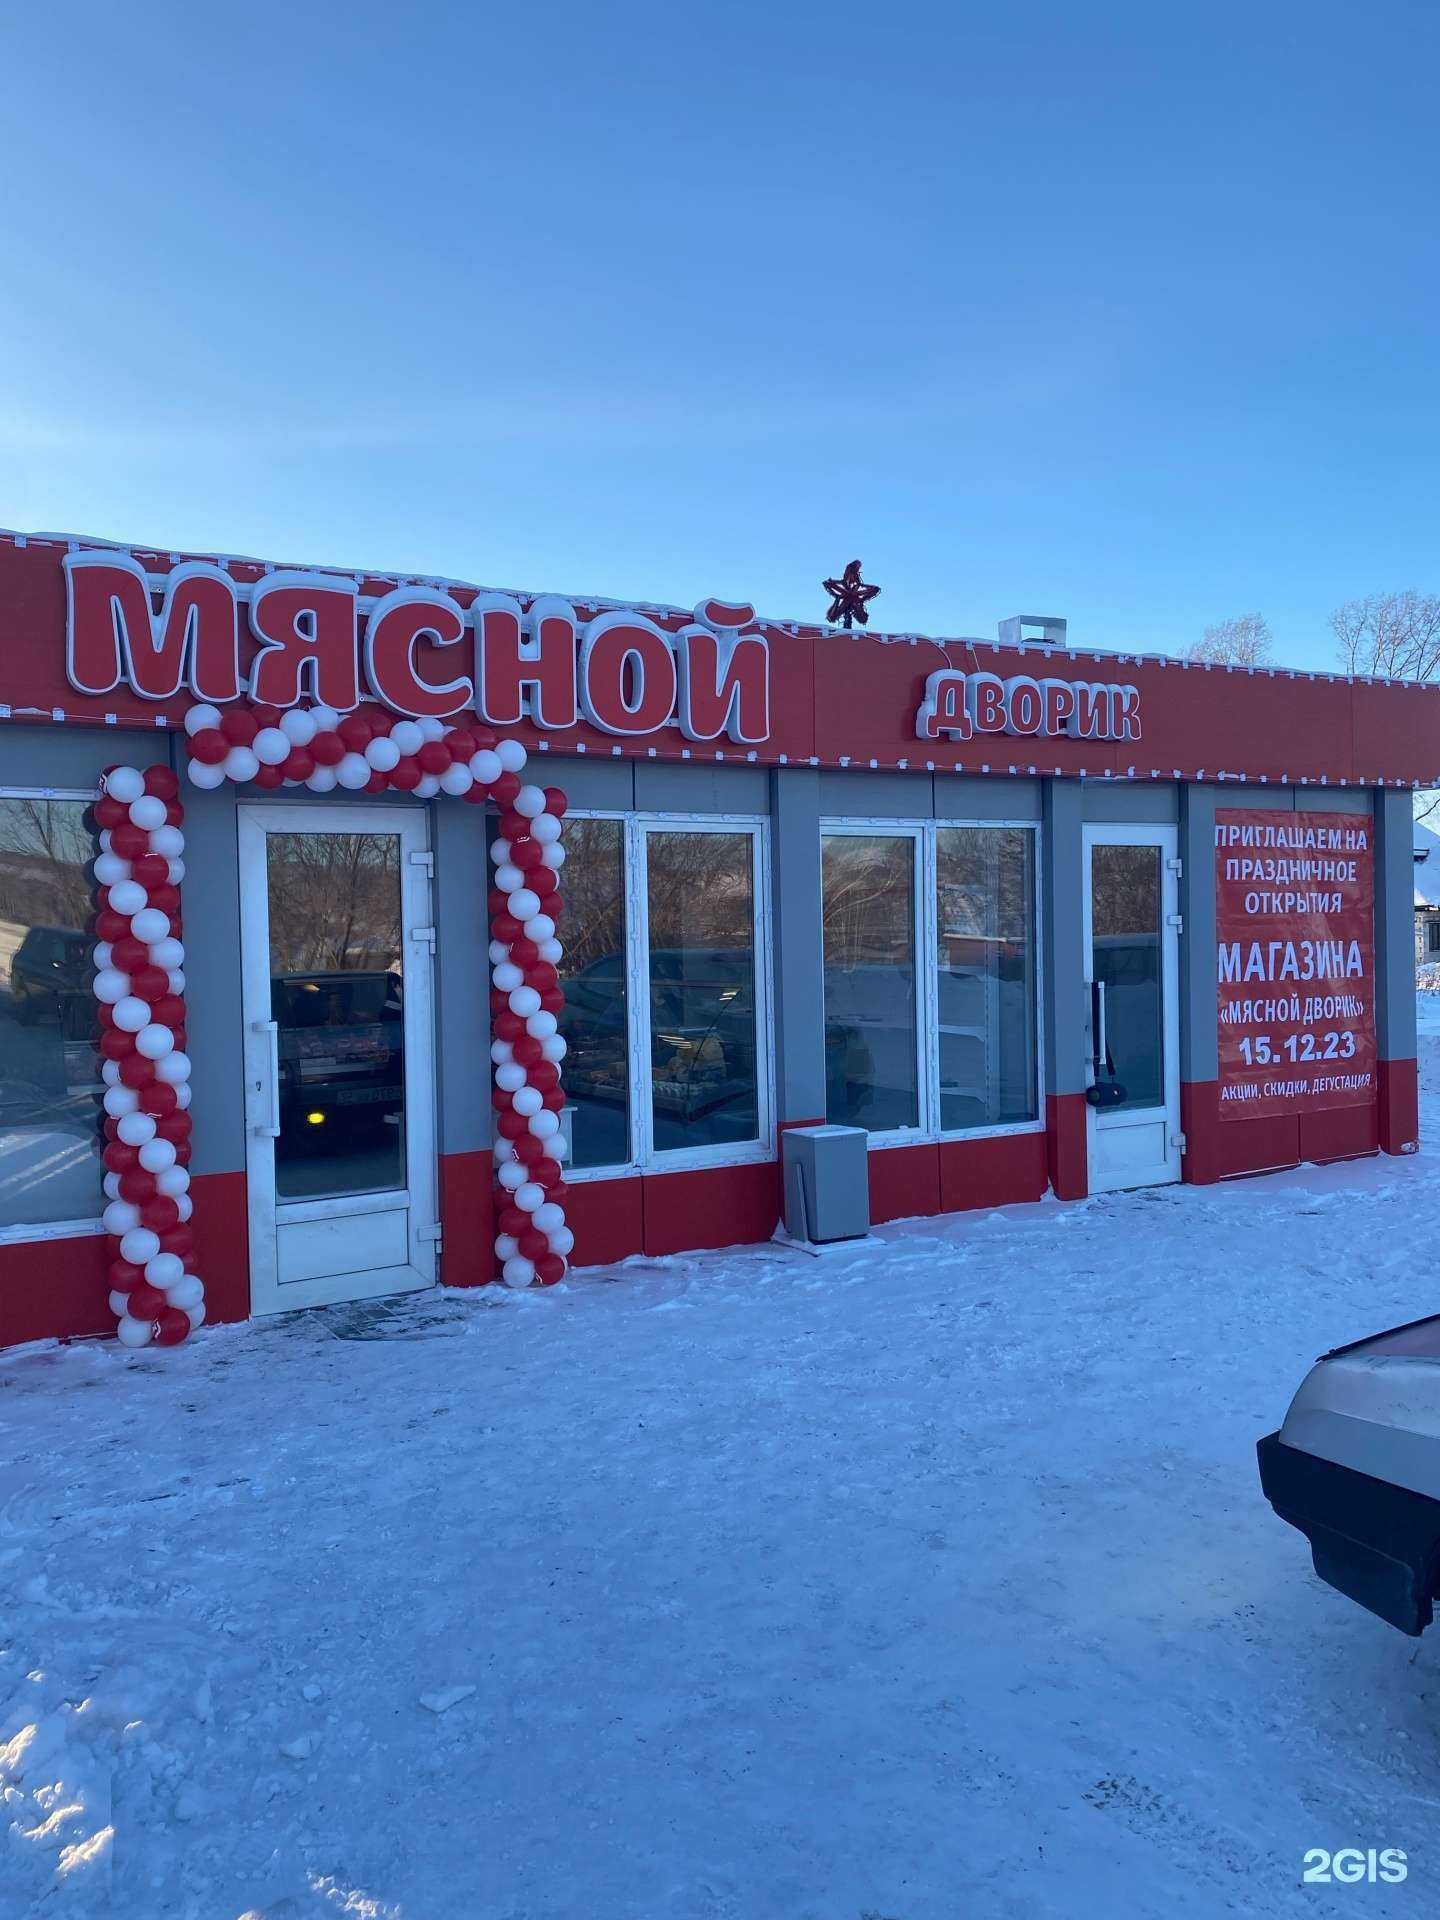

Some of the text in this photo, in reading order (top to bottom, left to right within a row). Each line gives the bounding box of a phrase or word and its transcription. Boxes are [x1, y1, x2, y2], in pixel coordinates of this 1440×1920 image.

[63, 552, 1141, 743] МЯСНОЙ ДВОРИК
[1214, 825, 1367, 850] ПРИГЛАШАЕМ НА
[1226, 859, 1357, 885] ПРАЗДНИЧНОЕ
[1245, 892, 1342, 914] ОТКРЫТИЯ
[1218, 940, 1363, 983] МАГАЗИНА
[1220, 993, 1364, 1025] «МЯСНОЙ ДВОРИК»
[1239, 1031, 1356, 1066] 15.12.23
[1221, 1073, 1371, 1102] АКЦИИ, СКИДКИ, ДЕГУСТАЦИЯ
